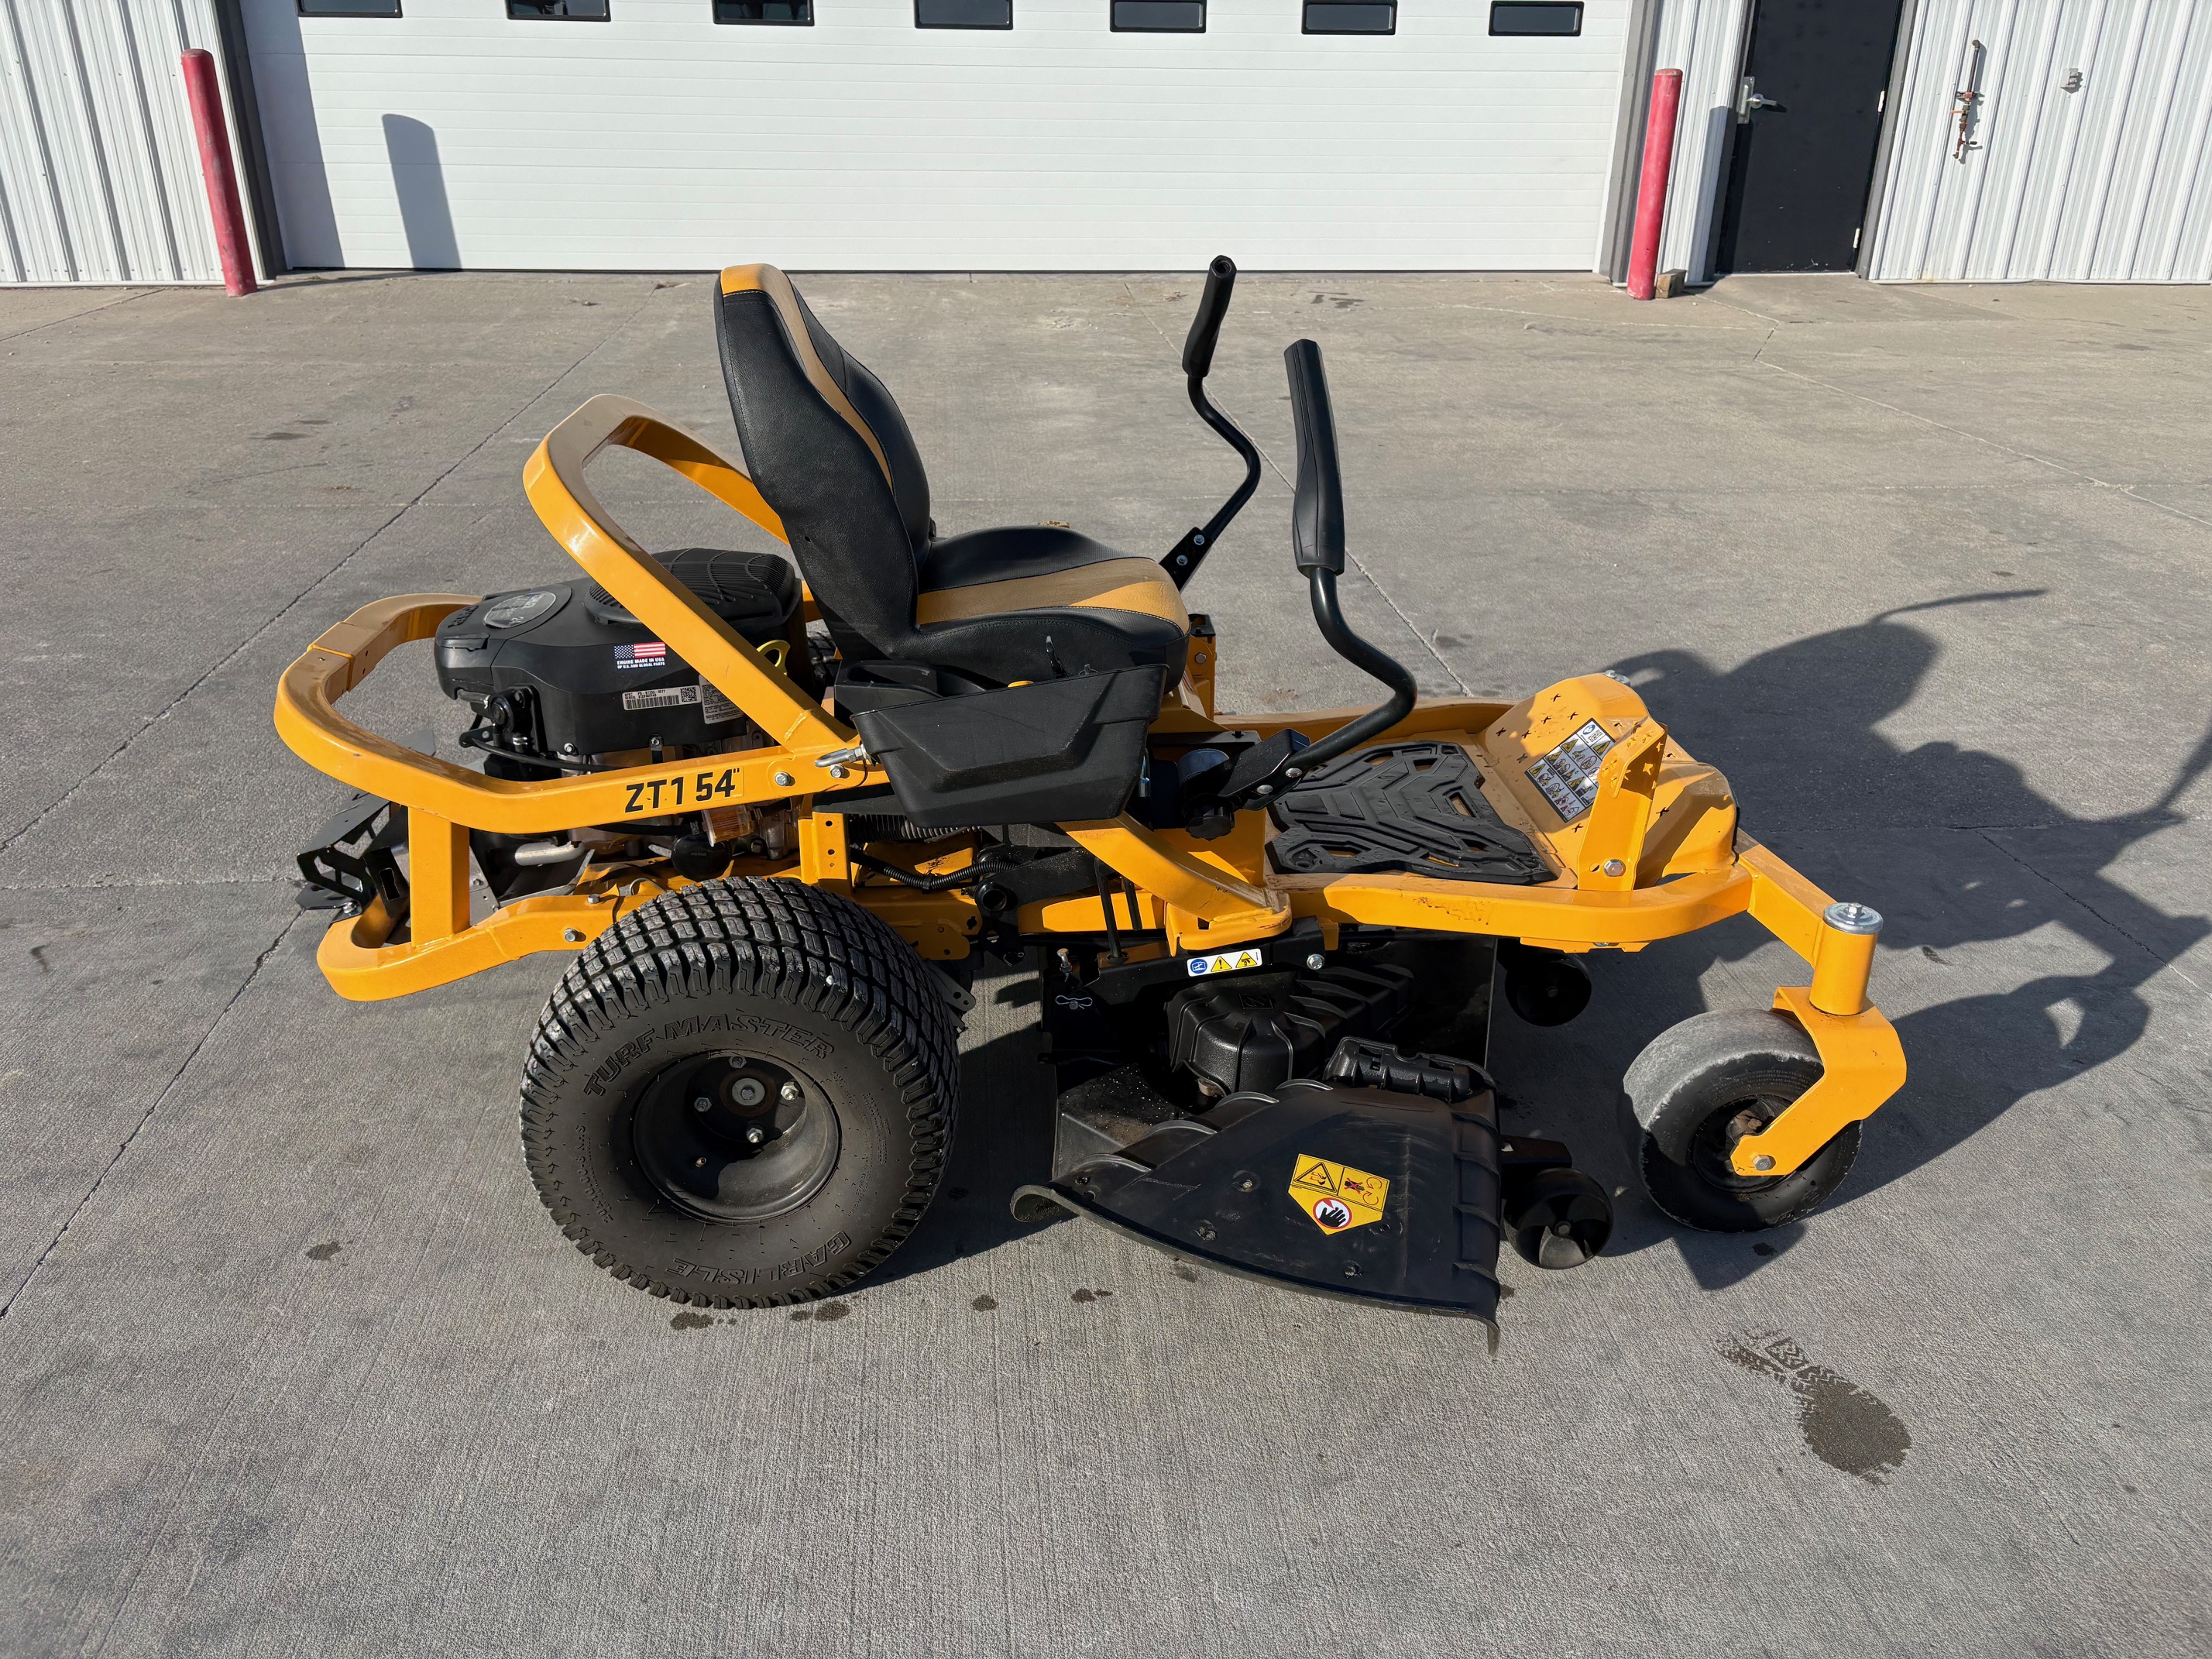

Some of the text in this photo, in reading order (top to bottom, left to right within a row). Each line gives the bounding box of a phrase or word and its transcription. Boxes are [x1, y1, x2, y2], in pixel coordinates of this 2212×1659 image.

[625, 768, 740, 813] ZT1 54"
[583, 1013, 835, 1097] TURF MASTER
[665, 1230, 852, 1285] CARLISLE
